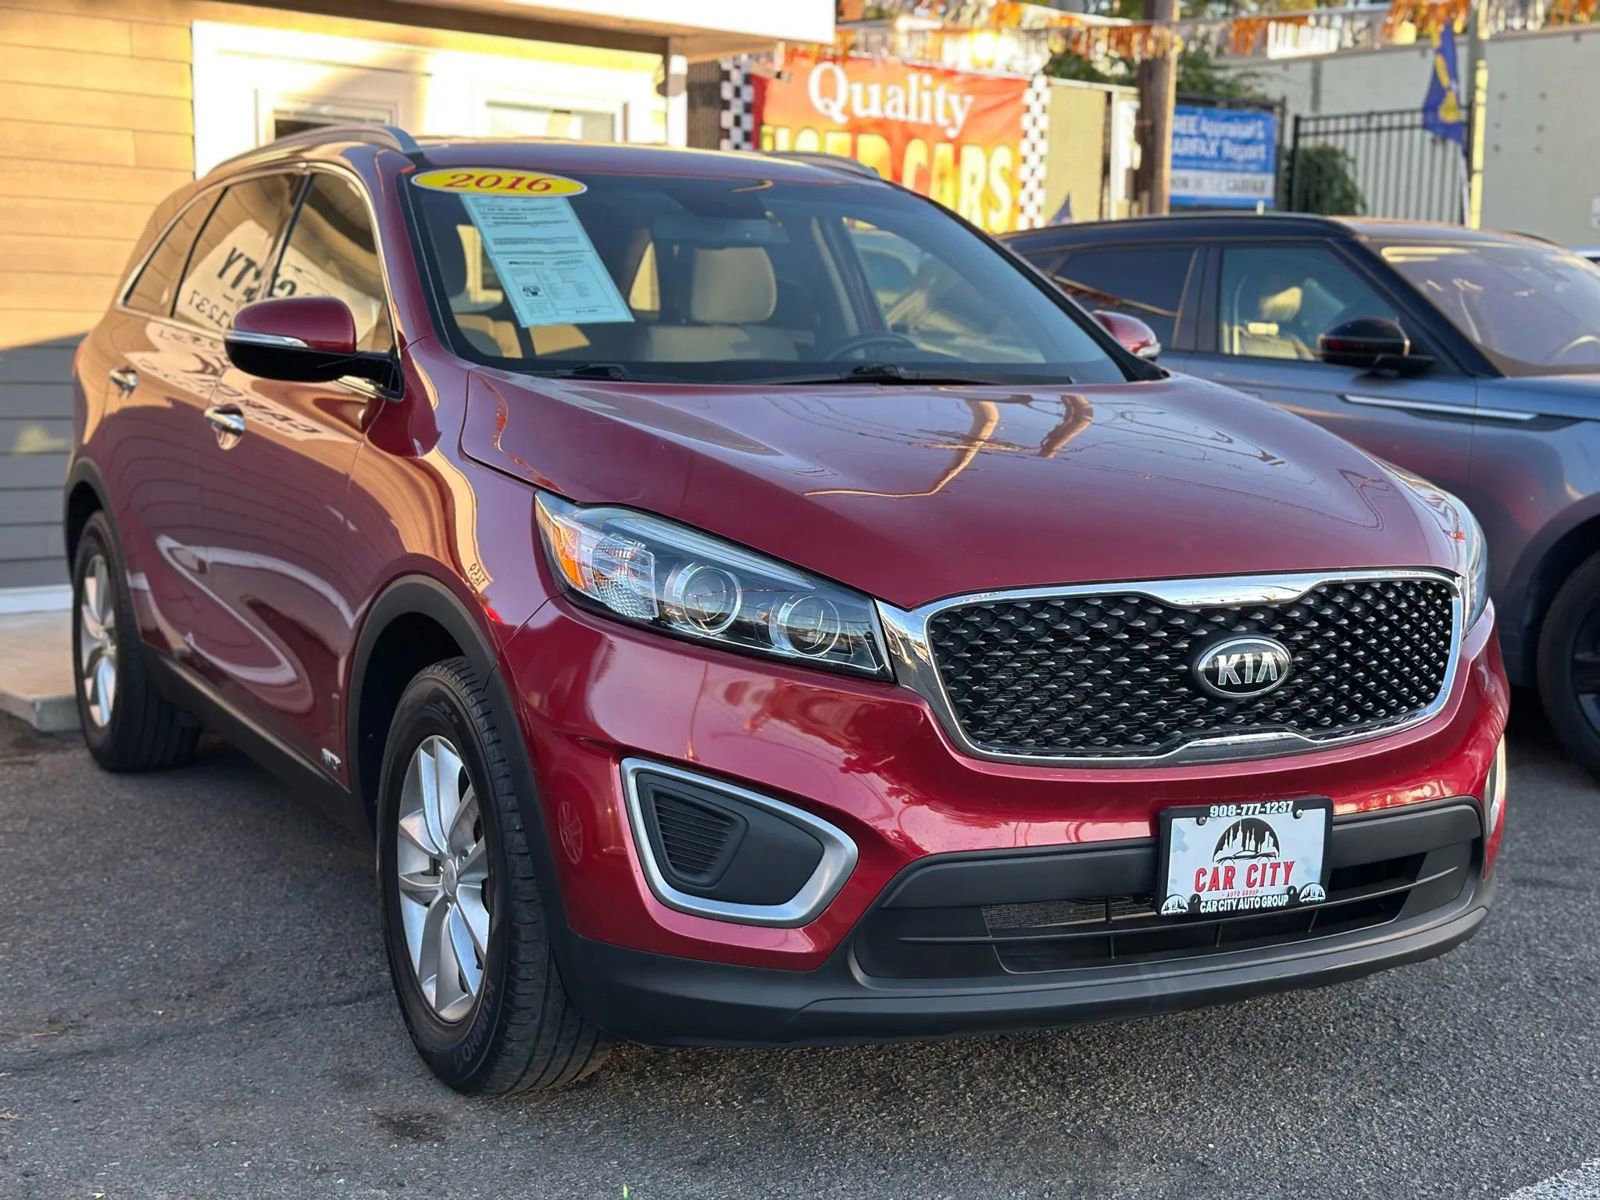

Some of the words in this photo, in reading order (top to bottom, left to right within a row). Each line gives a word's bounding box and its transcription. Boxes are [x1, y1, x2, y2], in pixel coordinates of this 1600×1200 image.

[808, 61, 974, 138] Quality
[444, 172, 559, 193] 2016
[902, 138, 1012, 234] CARS
[1216, 651, 1278, 686] KIA
[1209, 800, 1294, 818] 908-777-1237
[1194, 865, 1237, 893] CAR
[1245, 860, 1296, 888] CITY
[1200, 899, 1218, 914] CAR
[1219, 898, 1239, 913] CITY
[1238, 896, 1261, 911] AUTO
[1261, 894, 1289, 908] GROUP
[1226, 890, 1241, 898] AUTO
[1242, 889, 1259, 897] GROUP
